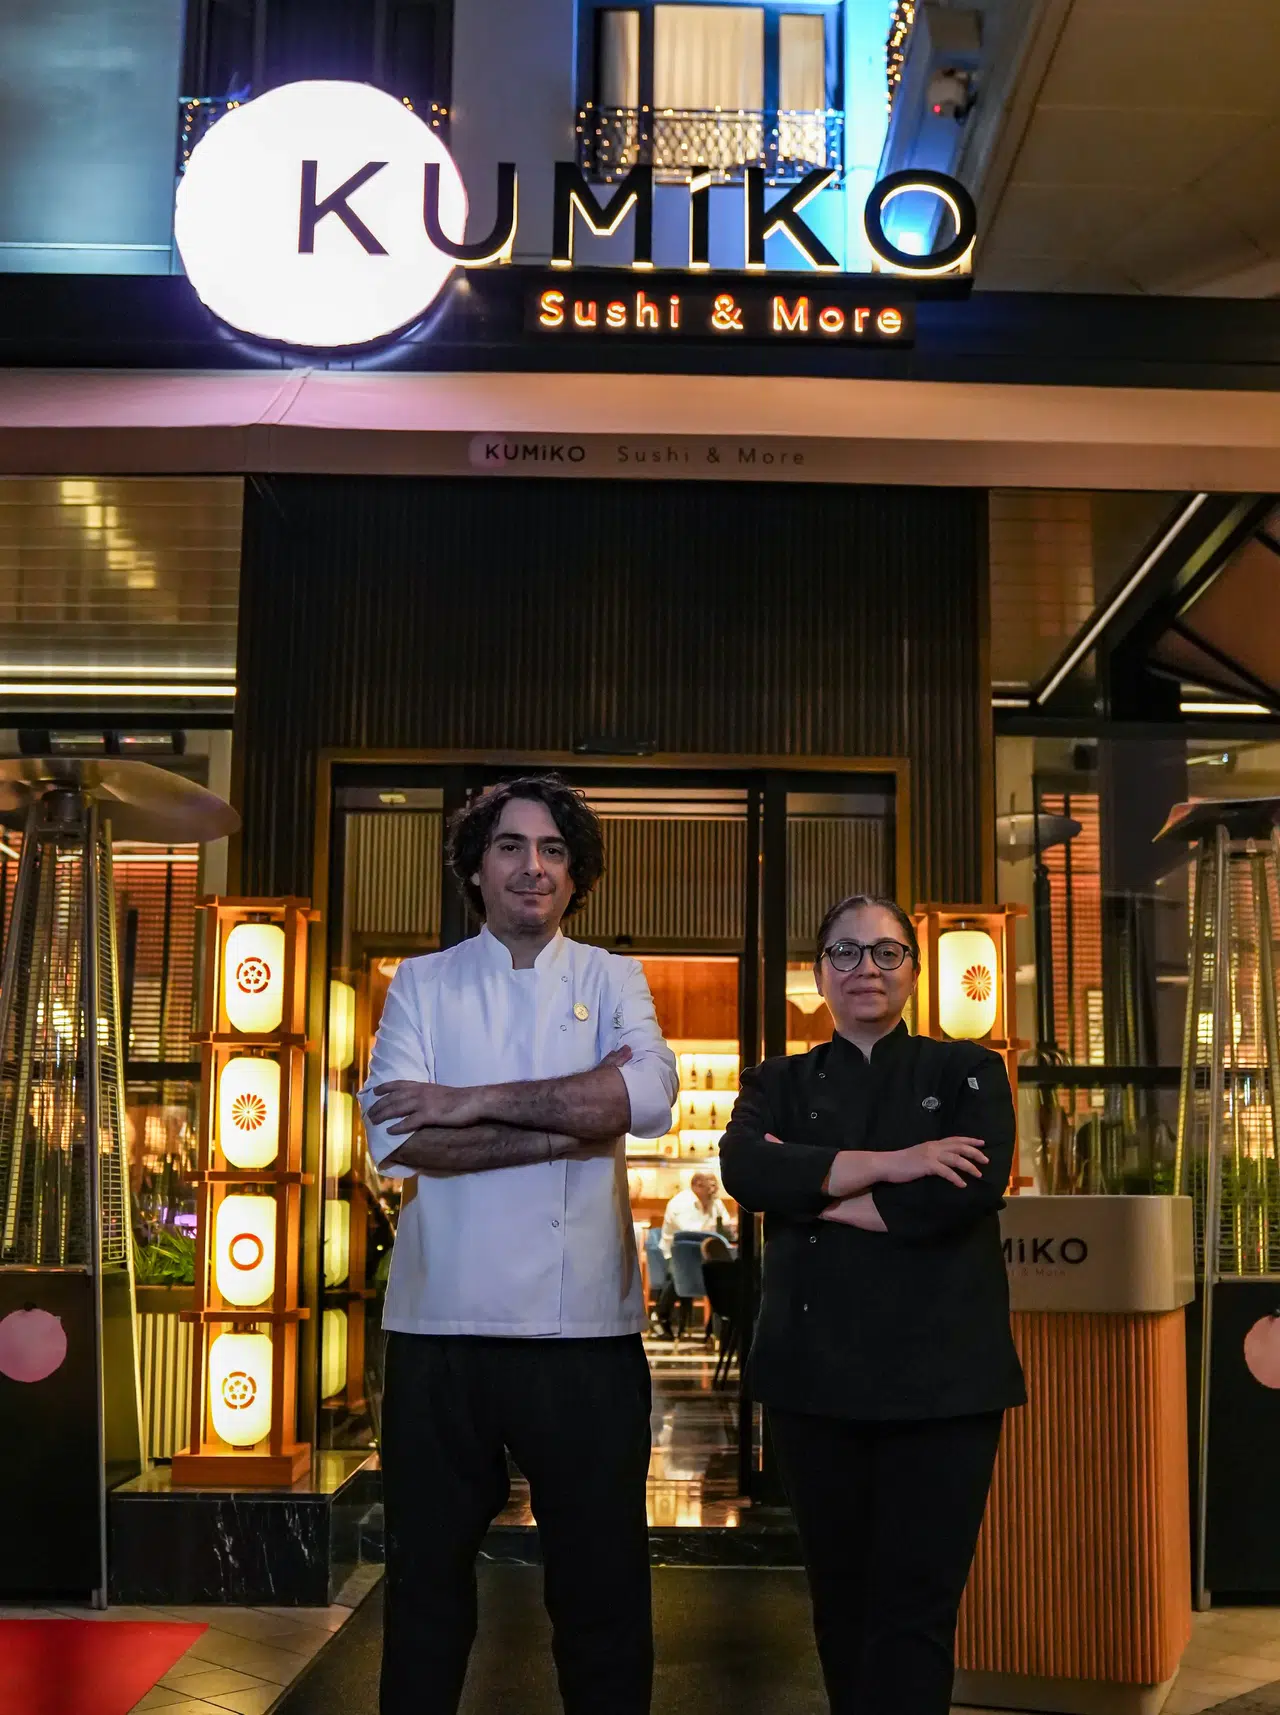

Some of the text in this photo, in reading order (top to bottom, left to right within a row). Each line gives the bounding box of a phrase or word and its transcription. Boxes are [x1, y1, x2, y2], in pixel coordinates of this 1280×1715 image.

[539, 290, 902, 334] Sushi & More
[617, 445, 689, 464] Sushi
[706, 446, 721, 464] &
[737, 447, 805, 466] More
